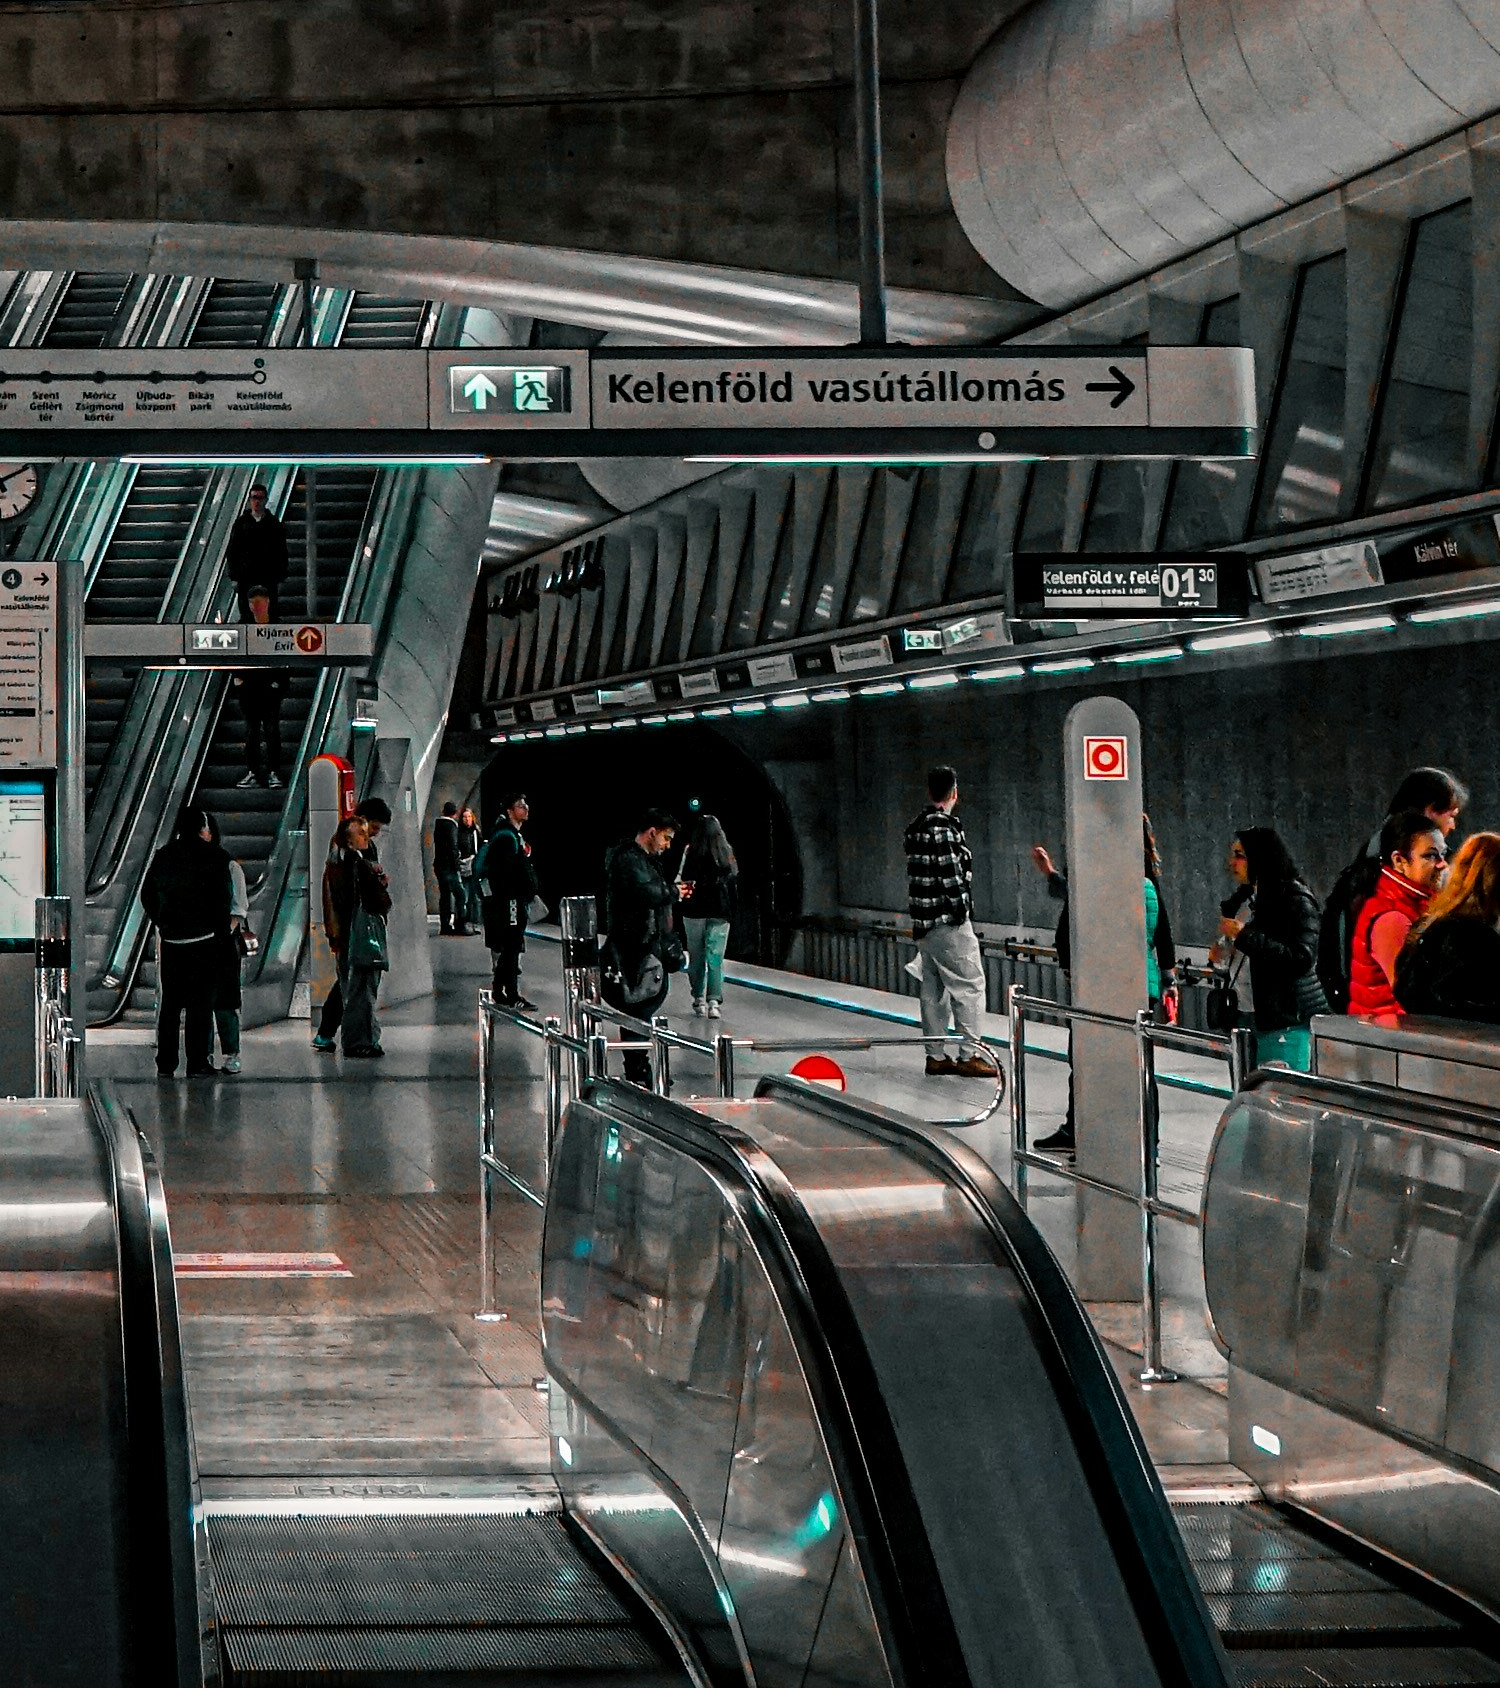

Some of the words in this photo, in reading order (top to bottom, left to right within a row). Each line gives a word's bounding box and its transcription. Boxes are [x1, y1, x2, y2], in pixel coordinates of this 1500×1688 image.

[608, 371, 794, 403] Kelenföld
[809, 371, 1065, 404] vasútállomás
[1115, 574, 1127, 584] v.
[1130, 569, 1159, 585] felé
[1162, 568, 1200, 598] 01
[1200, 568, 1214, 582] 30
[256, 628, 294, 640] Kijárat
[274, 642, 295, 651] Exit
